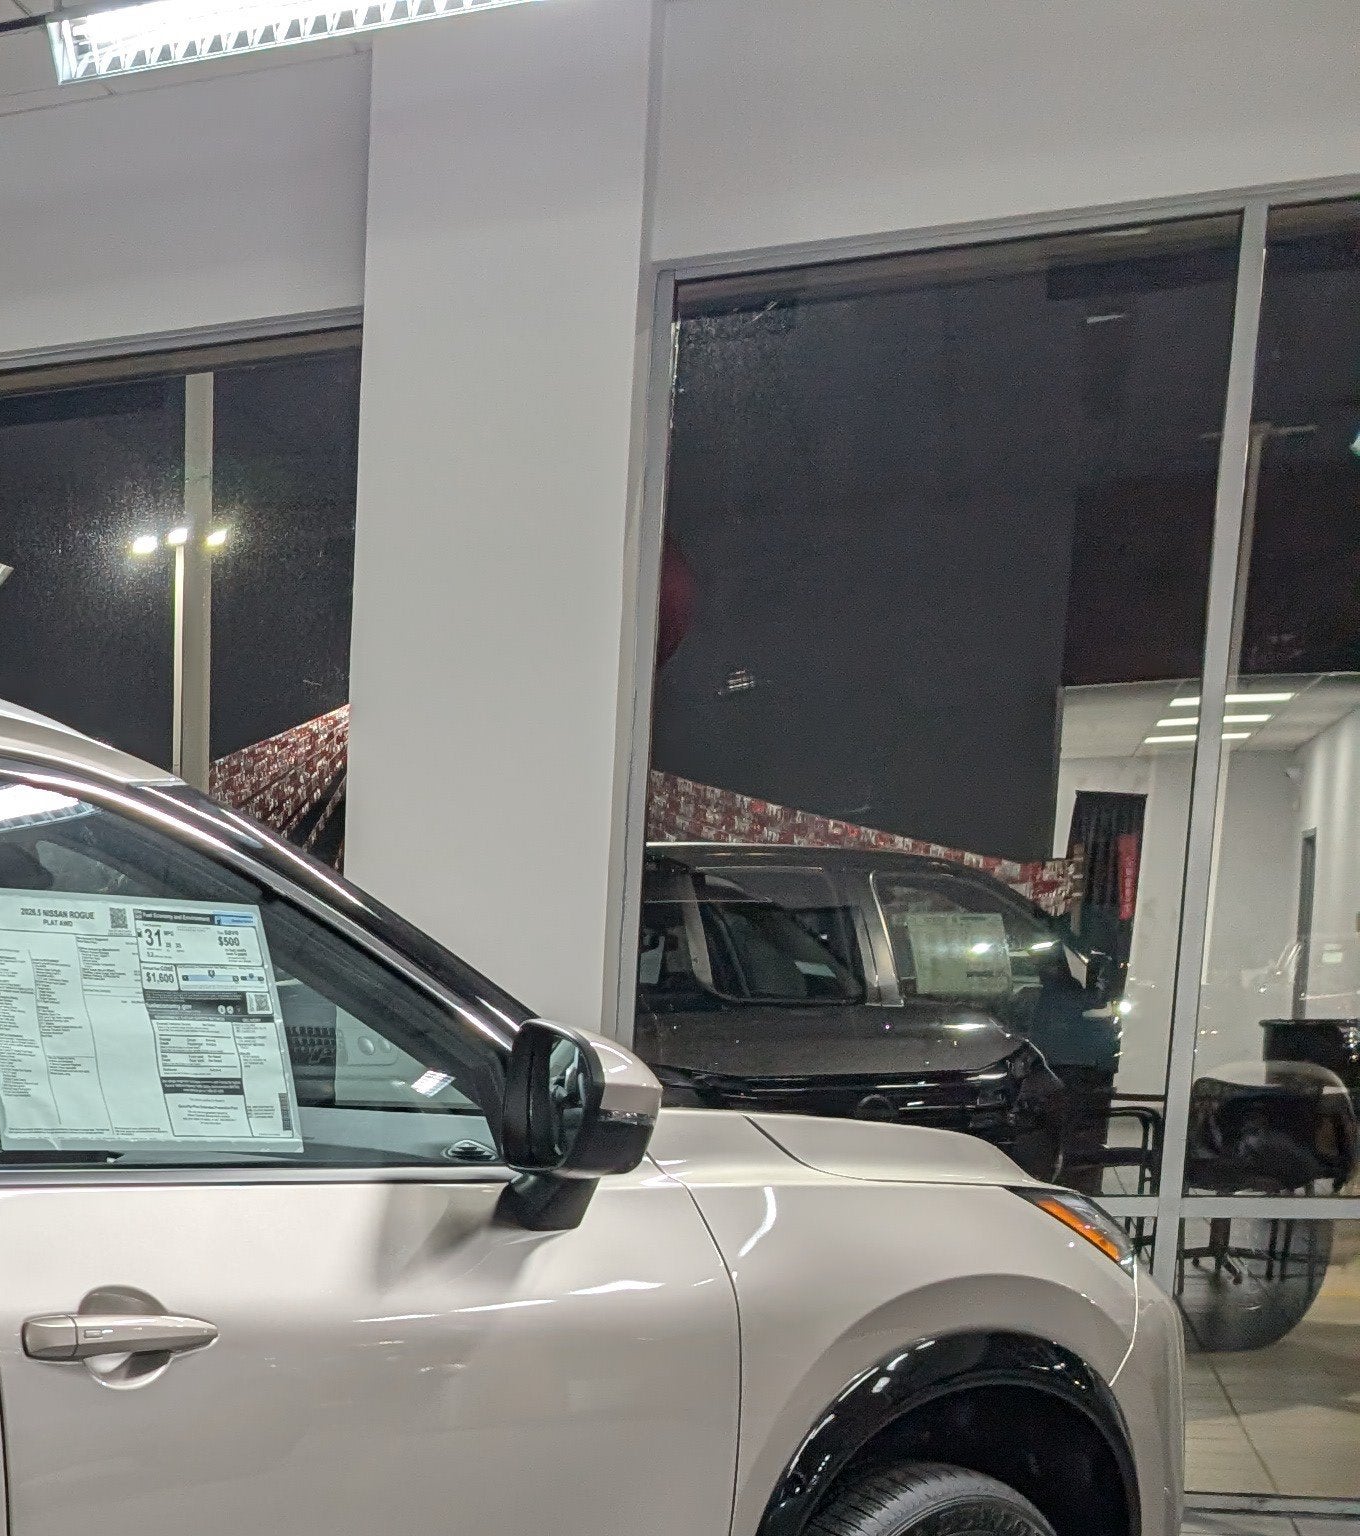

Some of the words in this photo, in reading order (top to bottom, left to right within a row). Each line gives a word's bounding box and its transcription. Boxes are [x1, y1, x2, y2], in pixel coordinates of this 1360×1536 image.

[69, 910, 95, 920] ROGUE
[144, 928, 162, 946] 31
[218, 936, 240, 947] $500
[146, 971, 175, 983] $1,600
